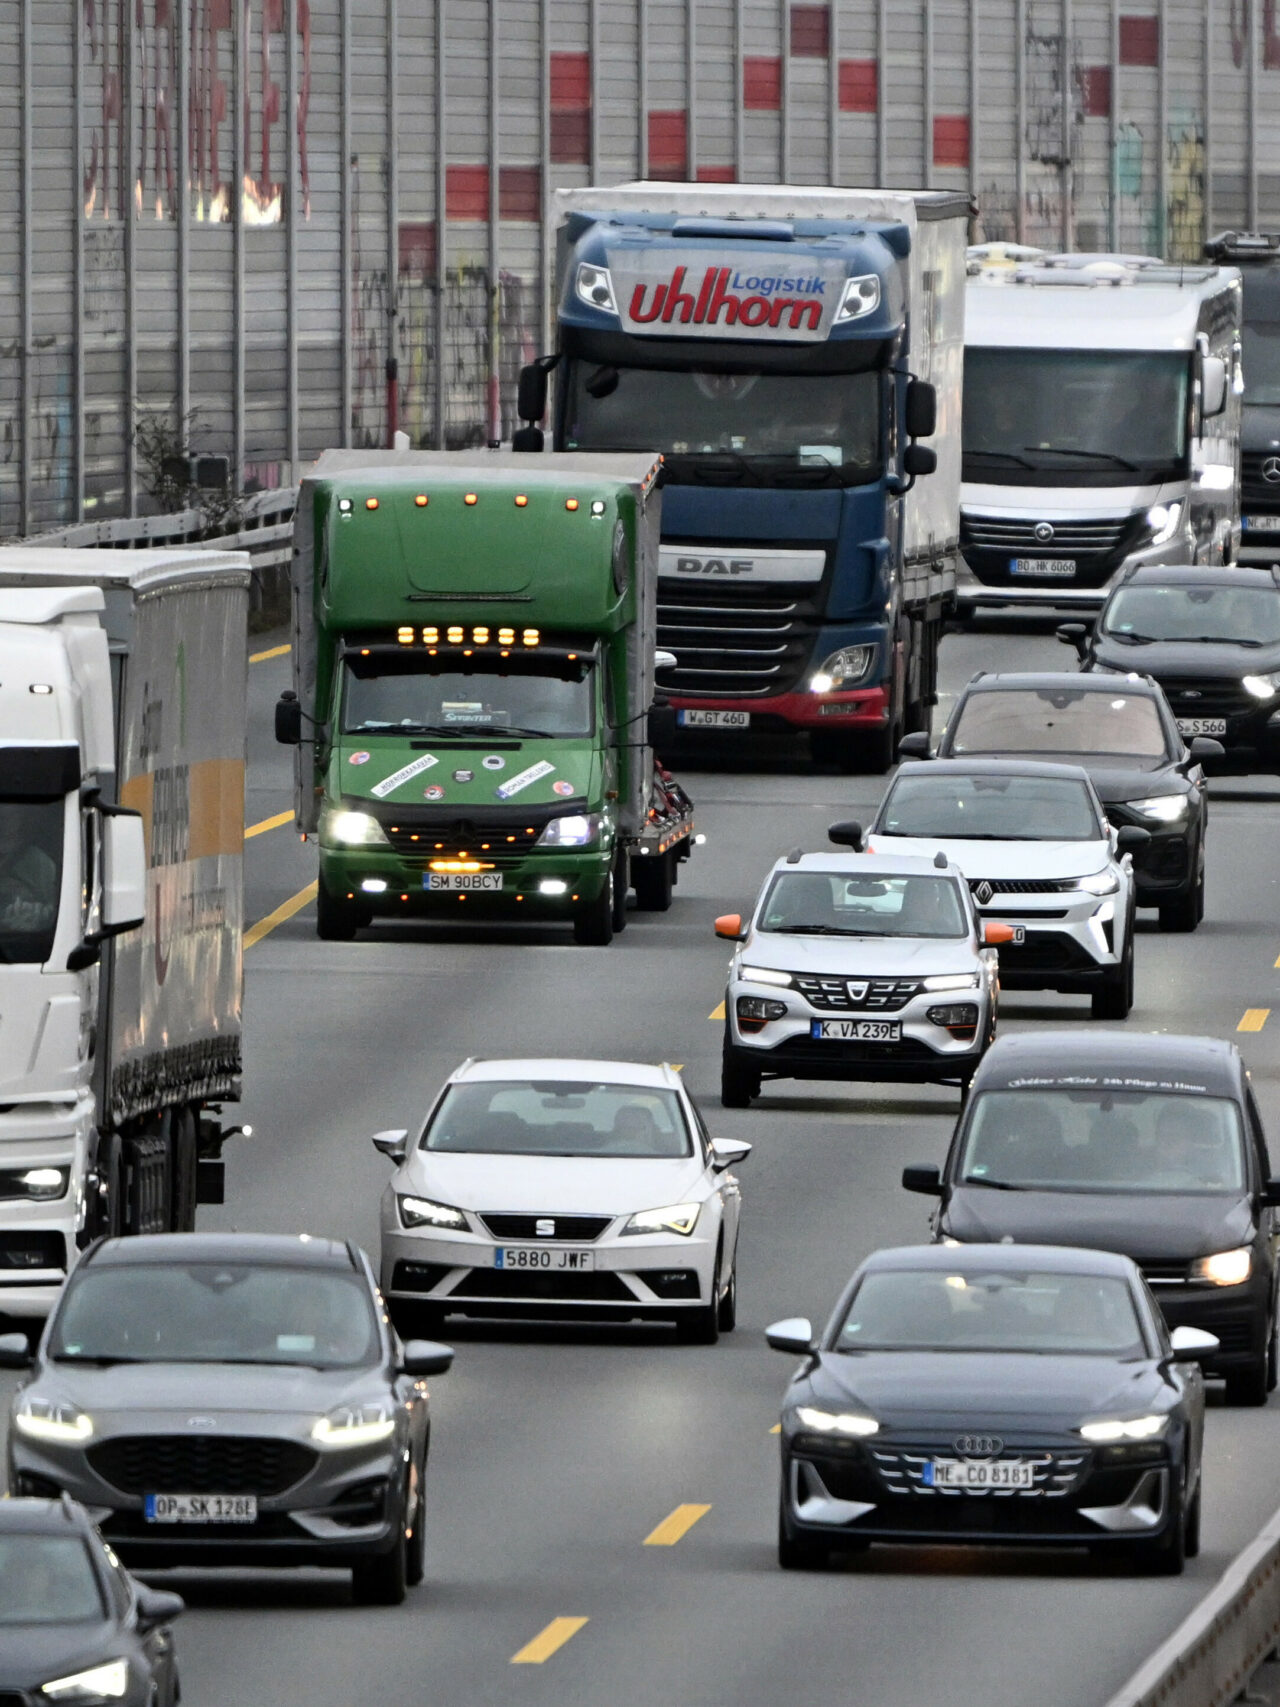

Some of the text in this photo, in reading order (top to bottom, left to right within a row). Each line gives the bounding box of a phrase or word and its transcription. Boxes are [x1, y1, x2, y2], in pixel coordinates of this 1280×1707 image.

[732, 271, 826, 297] Logistik
[629, 266, 824, 330] uhlhorn
[677, 558, 754, 574] DAF
[689, 712, 745, 725] W GT 460
[1202, 721, 1225, 733] 566
[430, 876, 450, 888] SM
[822, 1023, 898, 1039] K VA 239E
[506, 1250, 590, 1268] 5880 JWF
[992, 1468, 1029, 1484] 8181
